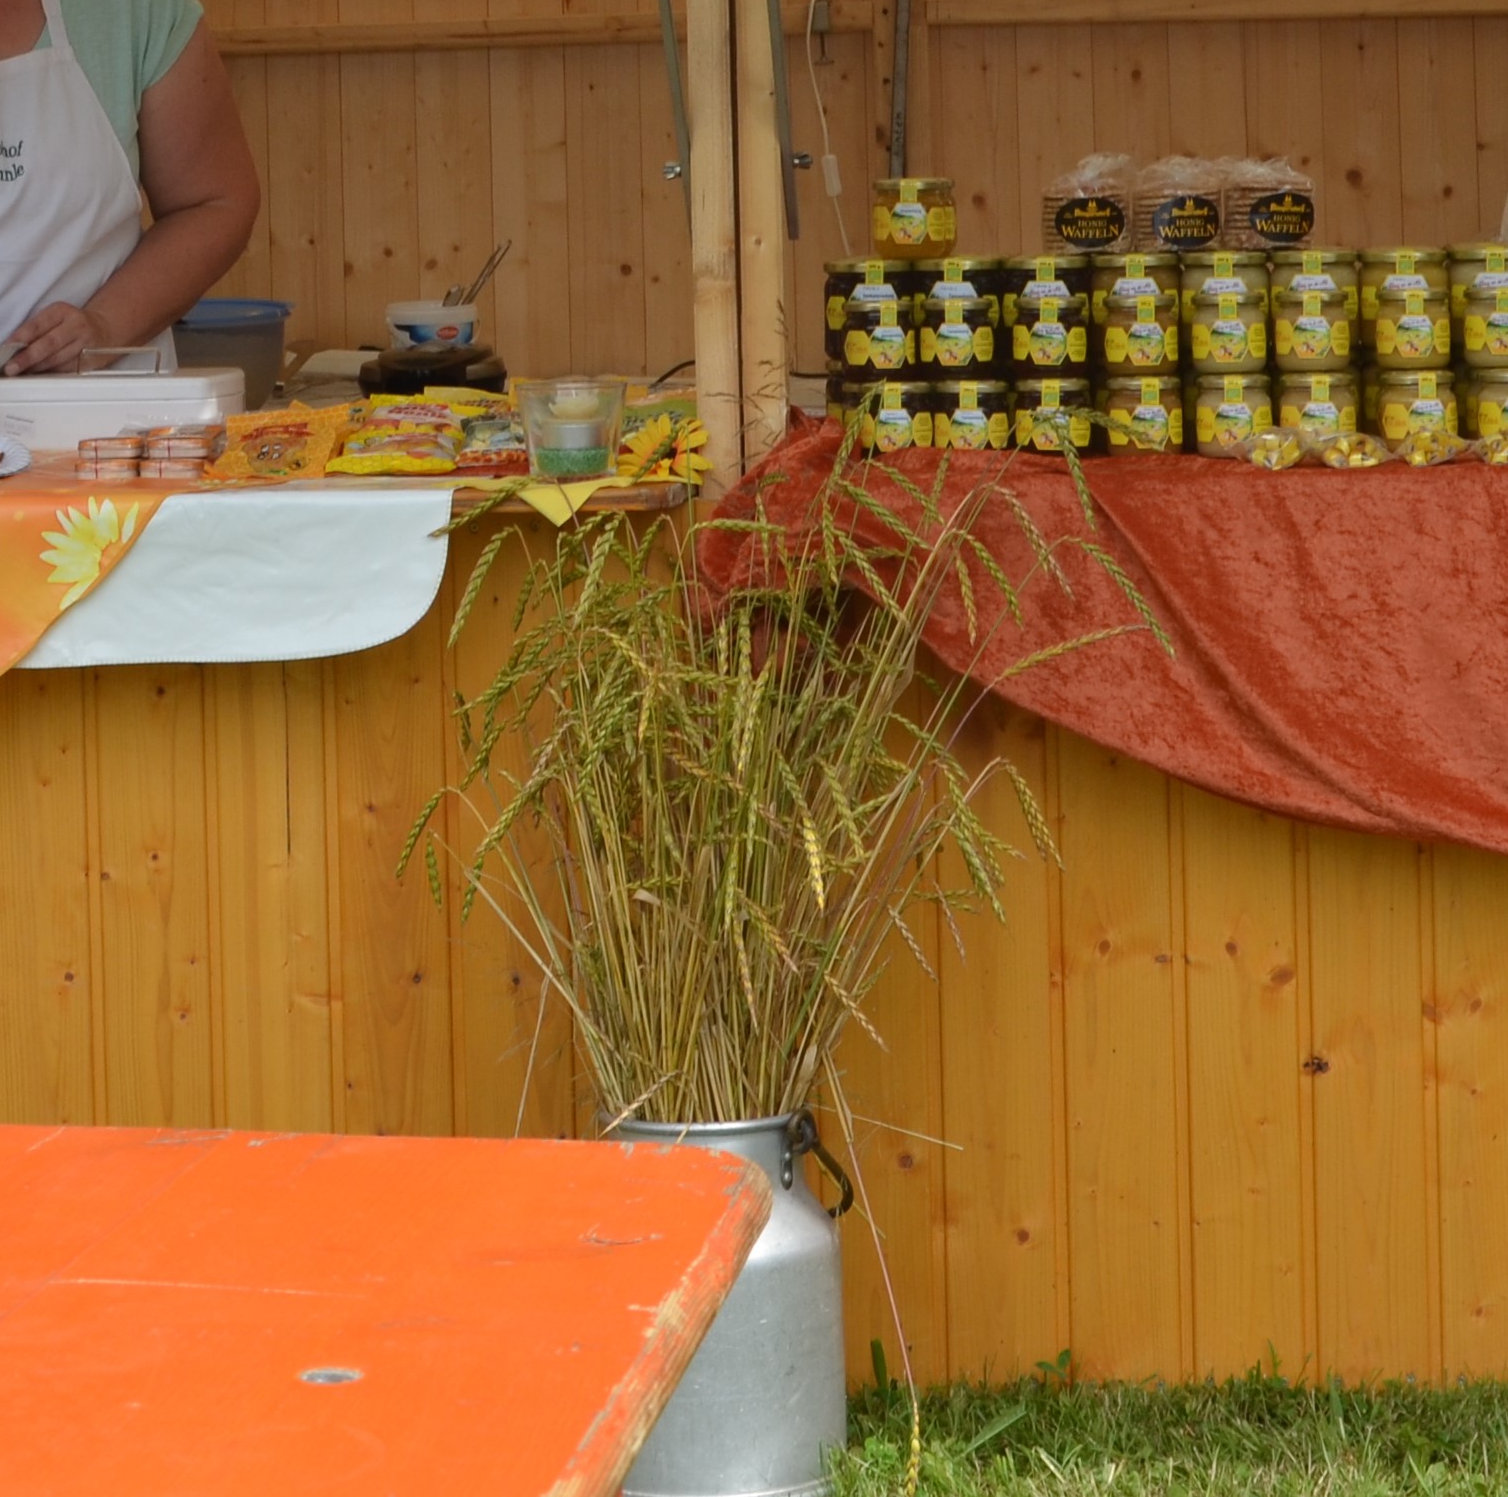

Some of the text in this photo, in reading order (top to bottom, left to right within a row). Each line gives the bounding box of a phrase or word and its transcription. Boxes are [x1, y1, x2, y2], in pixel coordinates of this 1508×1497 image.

[1077, 218, 1108, 229] HONIG
[1175, 218, 1204, 228] HONIG
[1272, 214, 1301, 224] HONIG
[1061, 223, 1119, 240] WAFFELN
[1158, 223, 1216, 239] WAFFELN
[1255, 218, 1310, 235] WAFFELN
